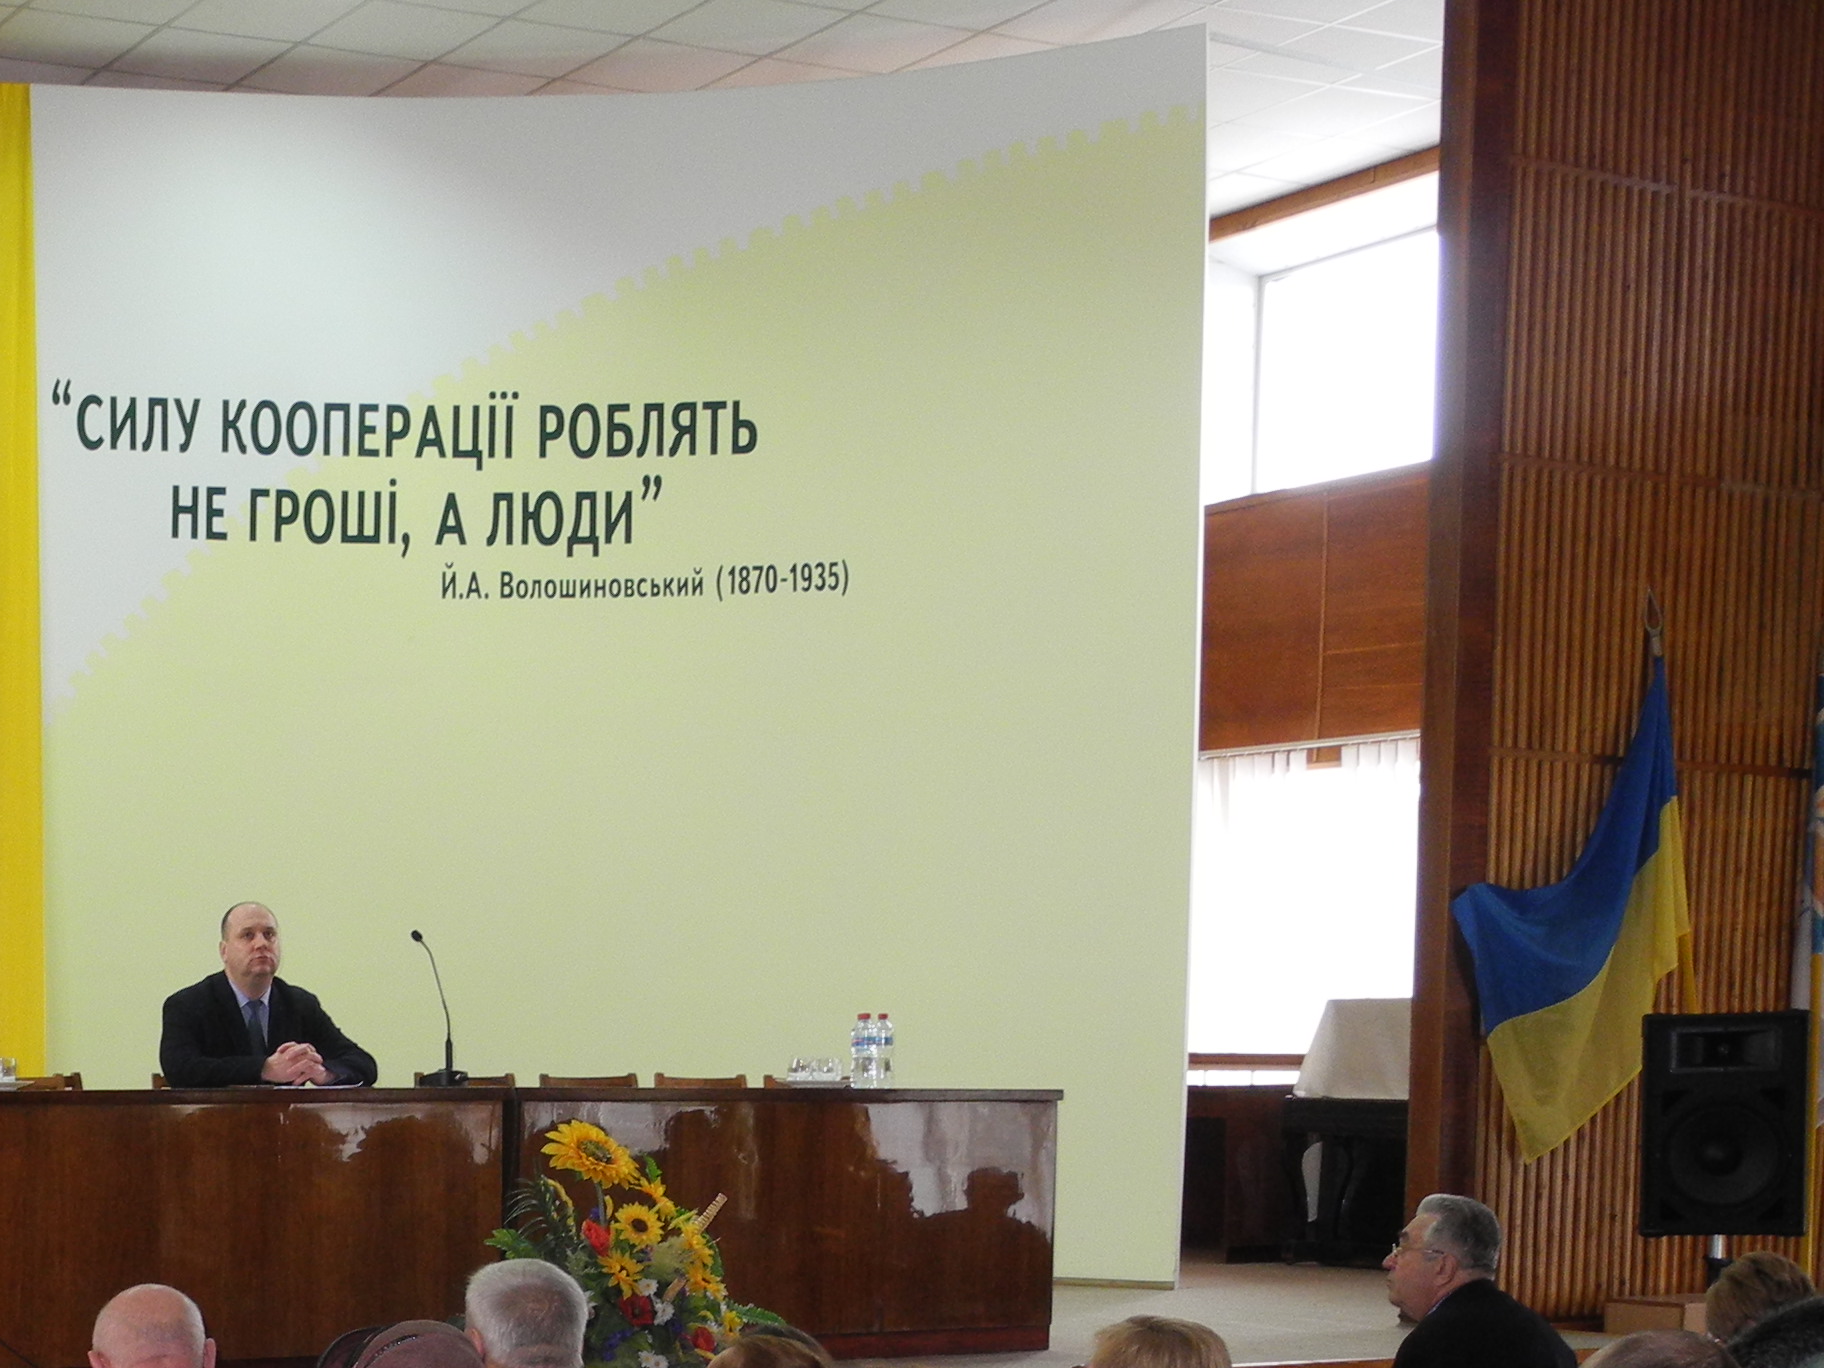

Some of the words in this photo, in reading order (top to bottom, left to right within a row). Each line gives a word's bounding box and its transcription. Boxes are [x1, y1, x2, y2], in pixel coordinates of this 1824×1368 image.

[221, 391, 519, 471] КООПЕРАЦІЇ
[539, 399, 758, 459] РОБЛЯТЬ
[171, 485, 228, 541] НЕ
[249, 478, 410, 558] ГРОШІ,
[435, 492, 467, 546] А
[441, 563, 490, 600] Й.А.
[500, 567, 704, 600] Волошиновський
[716, 559, 850, 602] (1870-1935)
